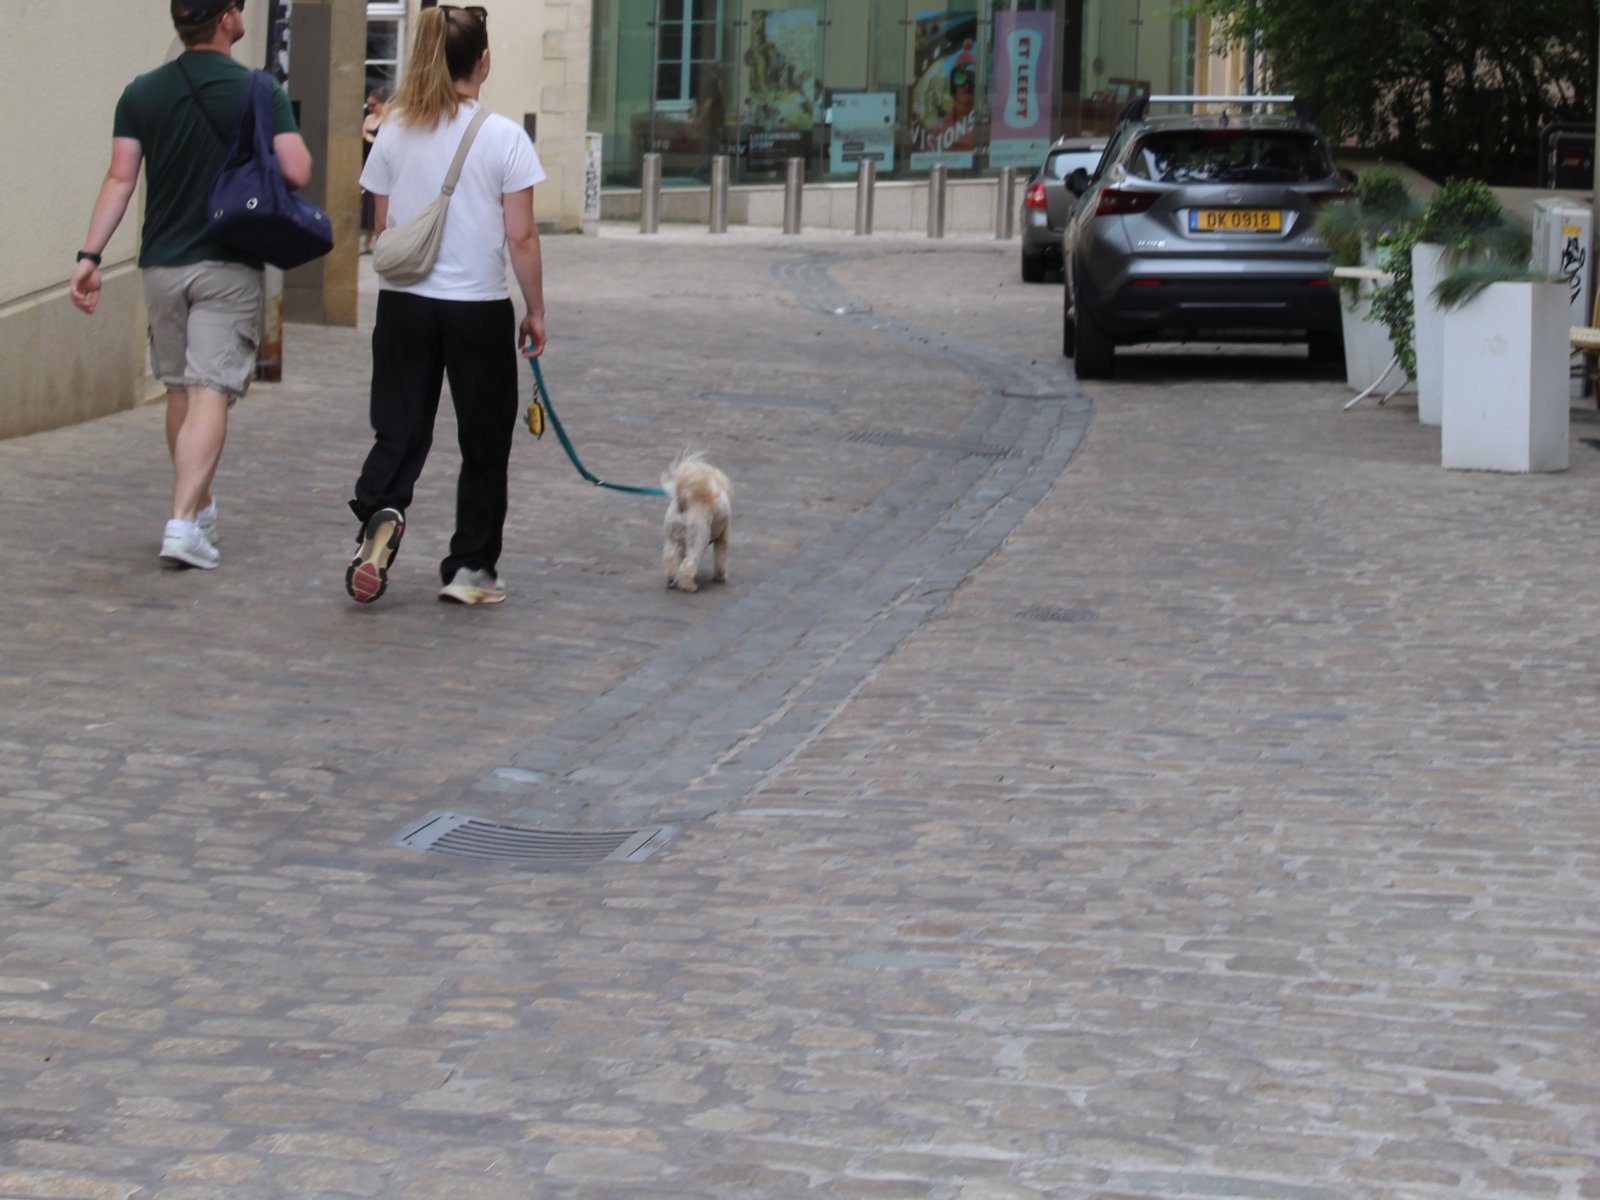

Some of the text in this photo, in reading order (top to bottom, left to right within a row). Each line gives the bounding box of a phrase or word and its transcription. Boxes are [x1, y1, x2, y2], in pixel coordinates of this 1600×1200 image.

[1016, 36, 1031, 119] ET LEEFT
[1231, 211, 1271, 227] 0918
